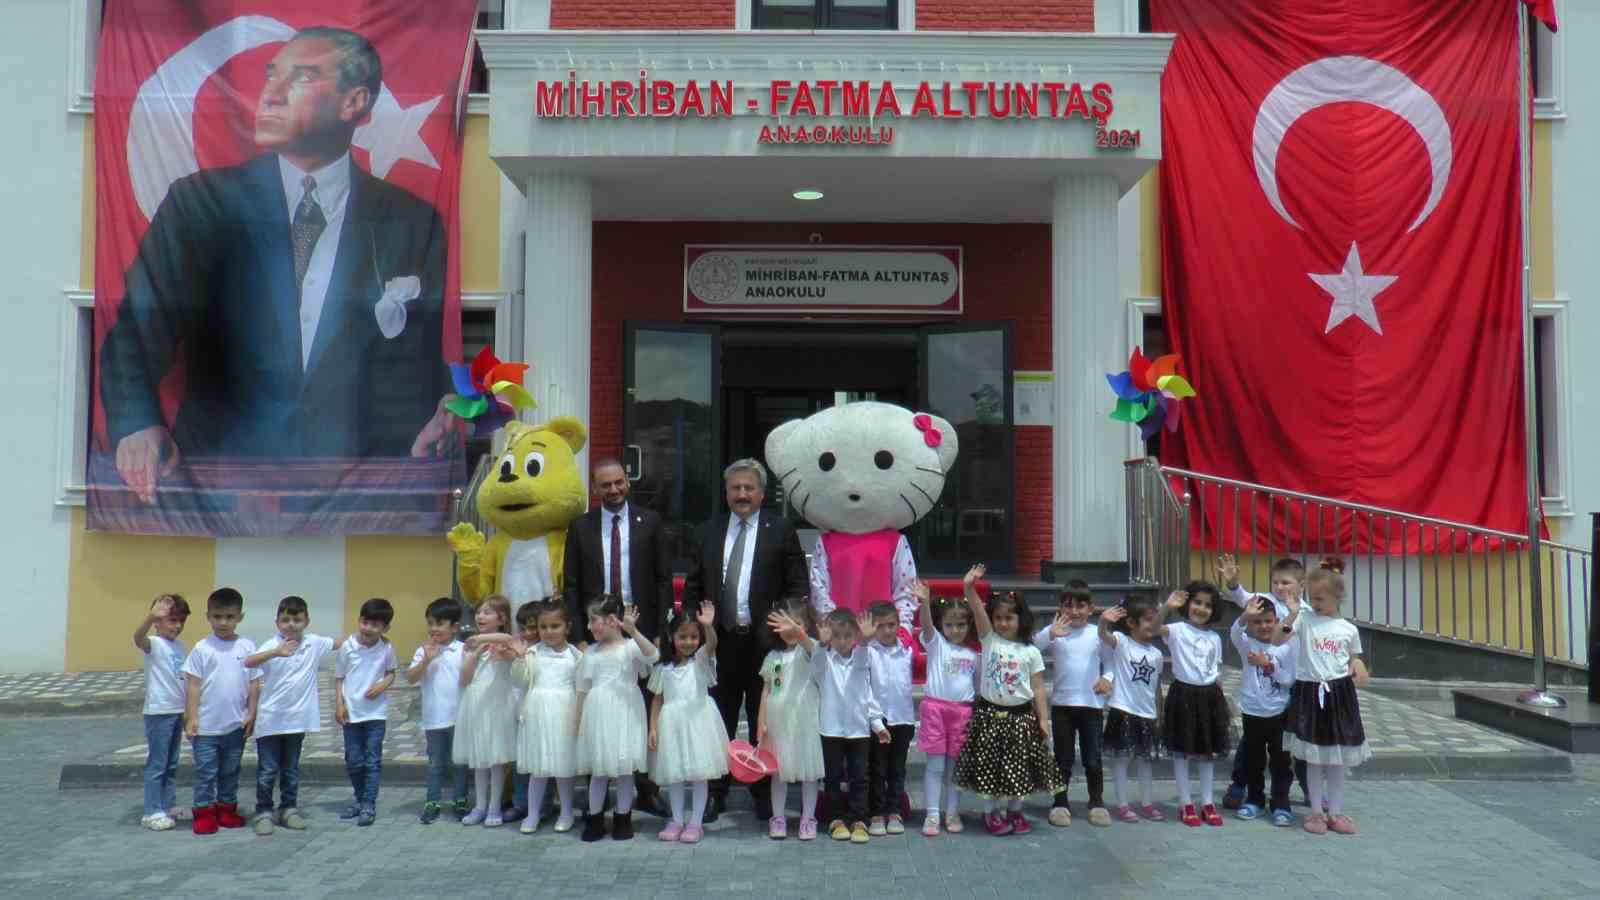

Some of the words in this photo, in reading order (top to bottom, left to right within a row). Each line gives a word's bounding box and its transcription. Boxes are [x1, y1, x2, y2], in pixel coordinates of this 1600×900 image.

[536, 69, 734, 118] MİHRİBAN
[769, 80, 901, 118] FATMA
[911, 81, 1114, 127] ALTUNTAŞ
[758, 126, 894, 144] ANAOKULU
[1096, 129, 1141, 148] 2021
[745, 267, 869, 282] MİHRİBAN-FATMA
[874, 272, 950, 285] ALTUNTAŞ
[745, 287, 826, 298] ANAOKULU
